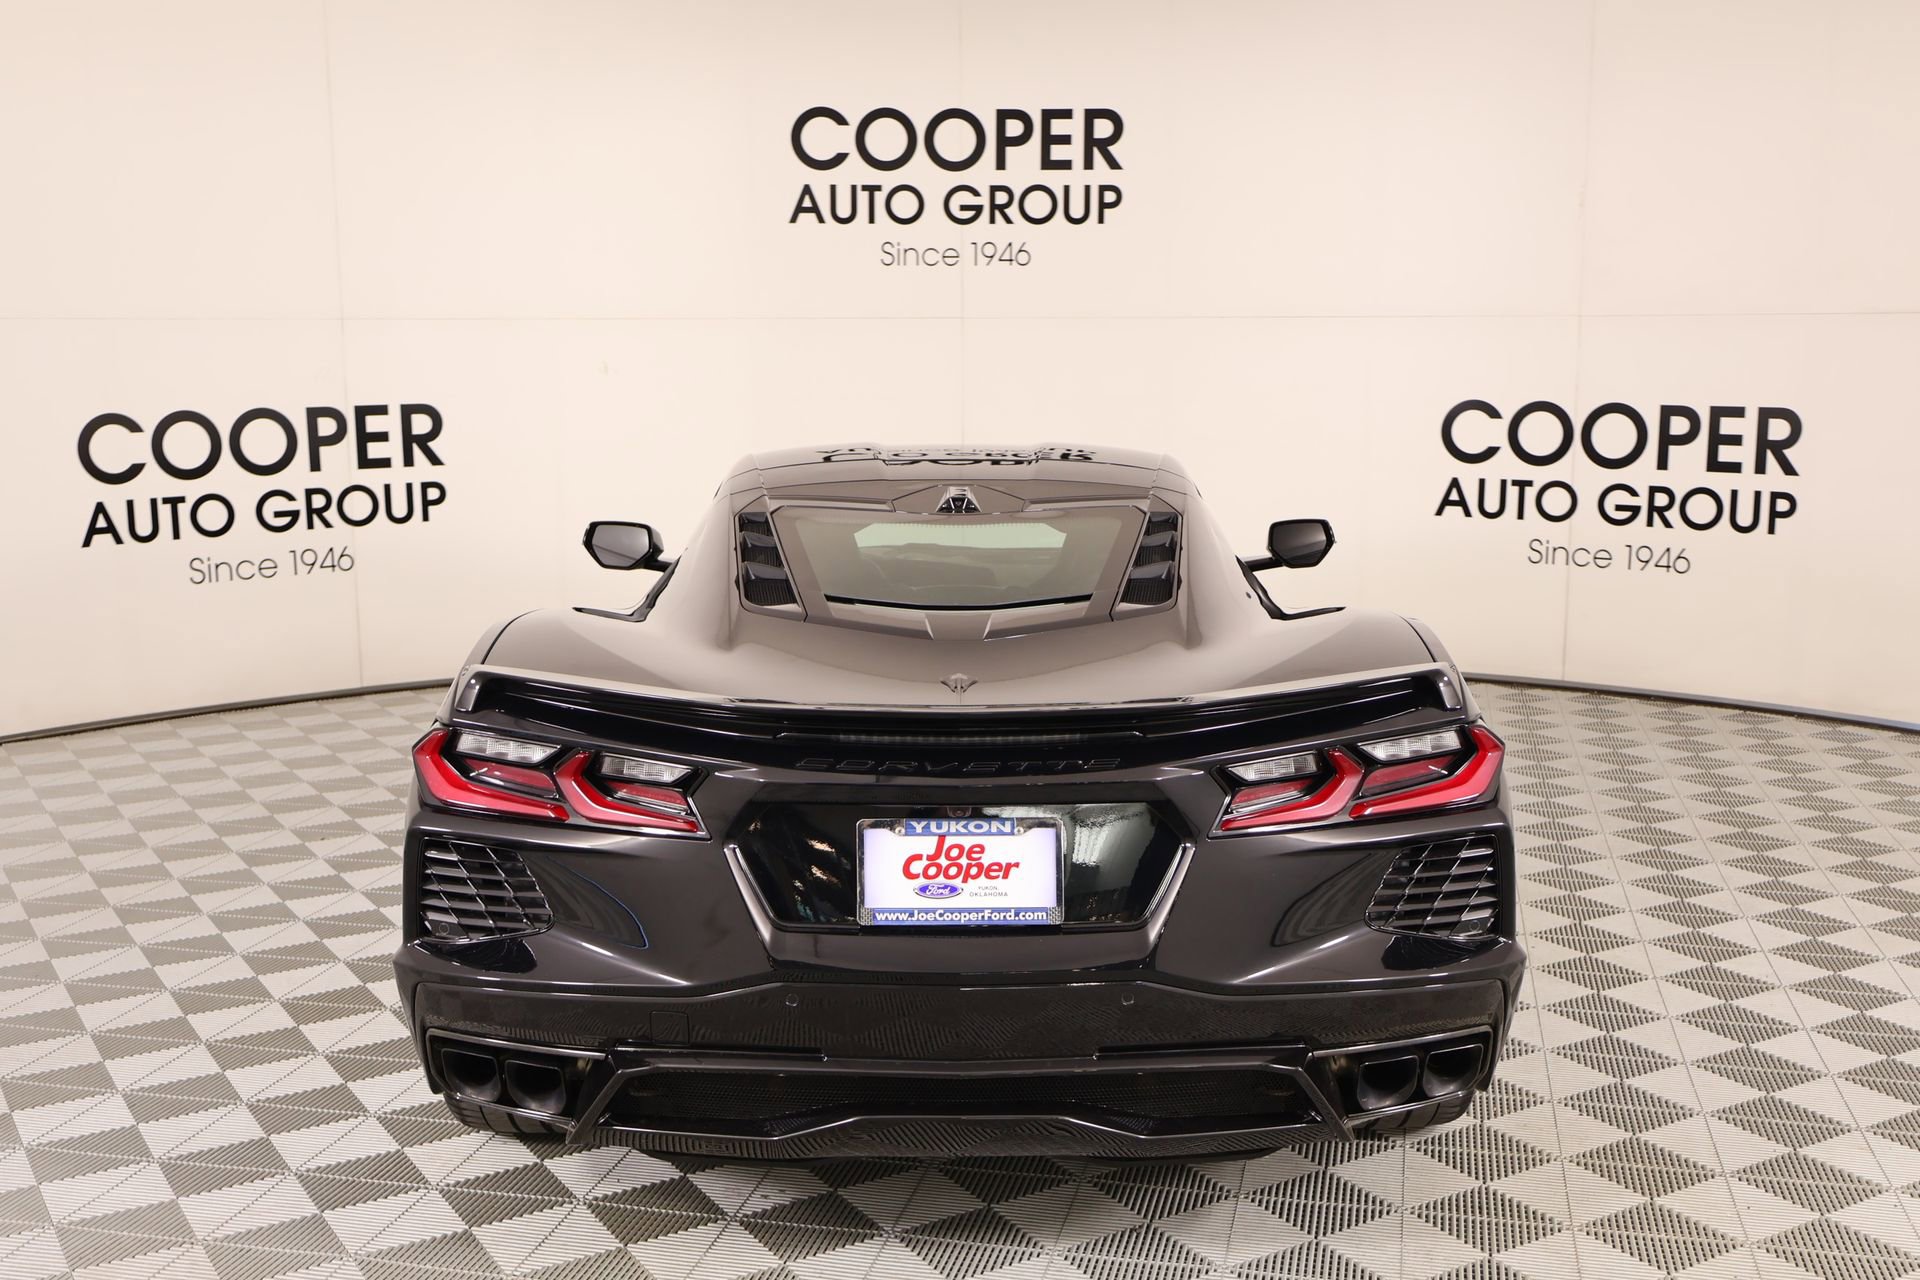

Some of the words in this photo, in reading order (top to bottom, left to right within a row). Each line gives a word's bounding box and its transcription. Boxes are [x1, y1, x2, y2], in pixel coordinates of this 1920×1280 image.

[790, 106, 1124, 172] COOPER
[788, 183, 925, 225] AUTO
[943, 183, 1122, 225] GROUP
[880, 241, 960, 267] Since
[970, 241, 1031, 267] 1946
[77, 404, 446, 485] COOPER
[1441, 400, 1803, 477] COOPER
[82, 493, 236, 549] AUTO
[256, 480, 447, 534] GROUP
[1435, 476, 1579, 523] AUTO
[1598, 482, 1798, 536] GROUP
[189, 557, 278, 585] Since
[288, 546, 355, 576] 1946
[1527, 538, 1613, 569] Since
[1625, 544, 1691, 575] 1946
[794, 757, 1121, 772] CORVETTE
[910, 821, 1012, 833] YUKON
[926, 835, 986, 862] Joe
[902, 853, 1020, 883] Cooper
[924, 884, 950, 896] Ford
[875, 909, 1047, 923] www.JoeCooperFord.com
